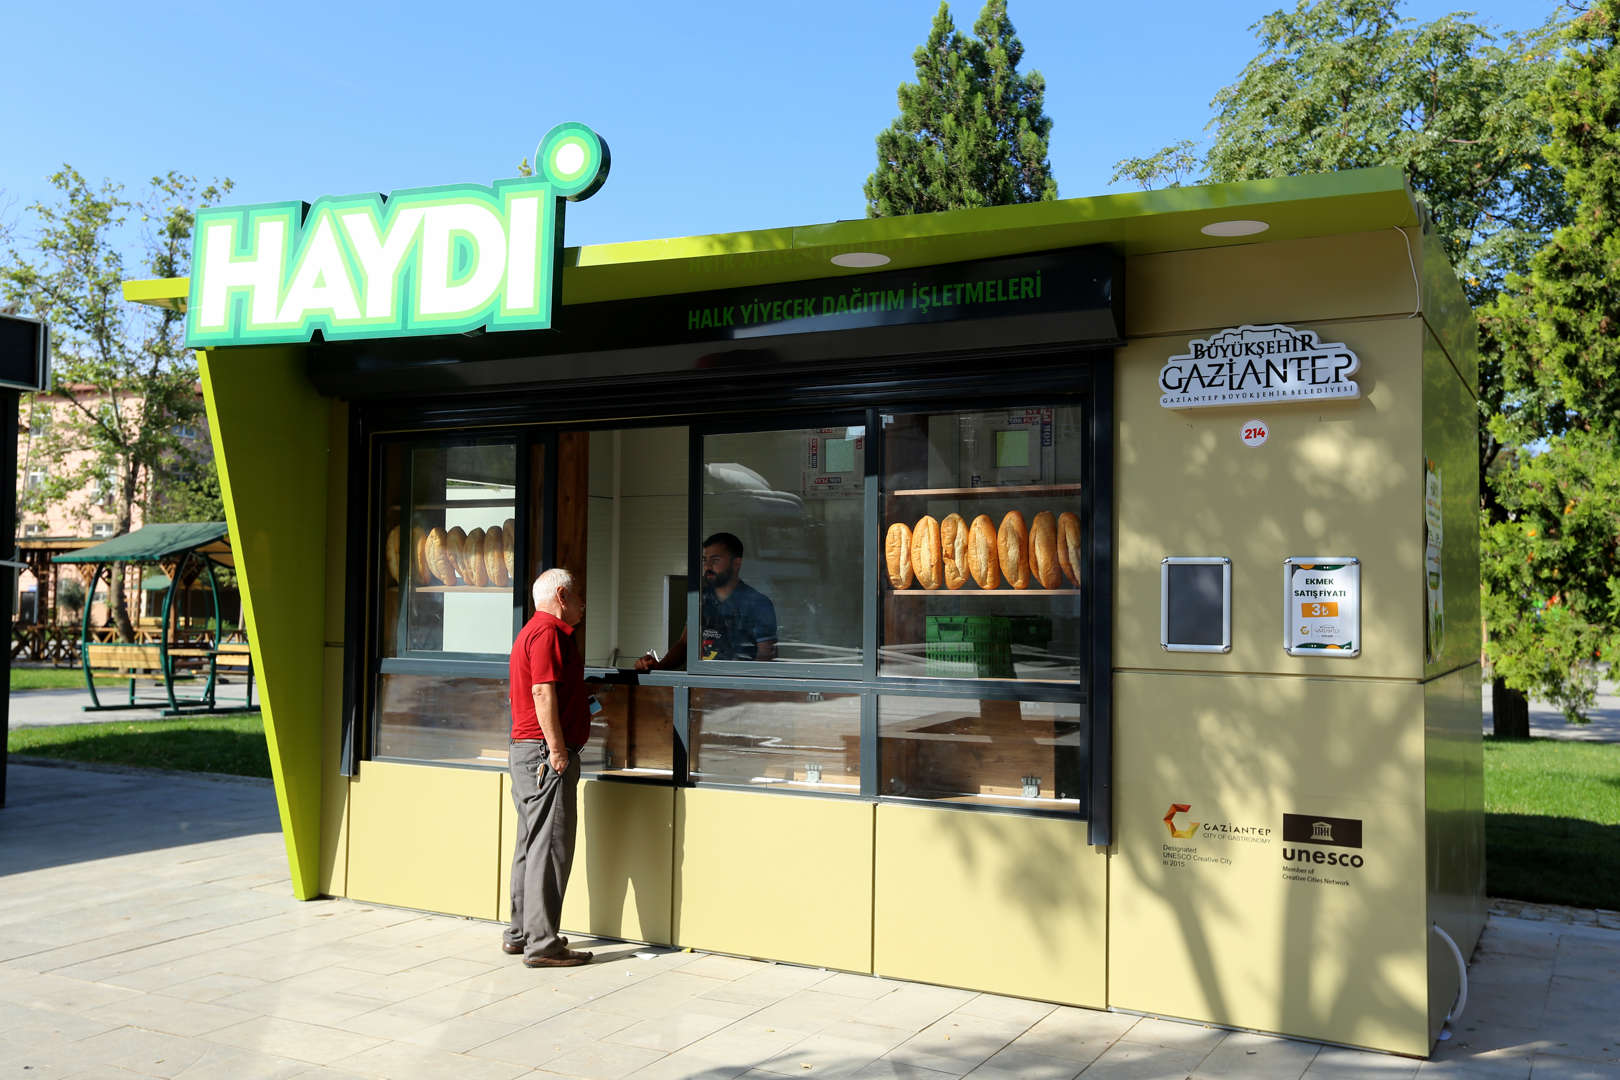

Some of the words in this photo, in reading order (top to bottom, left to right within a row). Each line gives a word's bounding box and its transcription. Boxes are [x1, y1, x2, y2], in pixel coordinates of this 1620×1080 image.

[194, 134, 590, 334] HAYDİ
[688, 306, 735, 330] HALK
[741, 298, 817, 324] YİYECEK
[822, 287, 905, 317] DAĞITIM
[911, 269, 1042, 314] İŞLETMELERİ
[1161, 354, 1352, 394] GAZİANTEP
[1162, 394, 1219, 404] GAZİANTEP
[1222, 389, 1287, 400] BÜYÜKŞEHİR
[1291, 385, 1354, 396] BELEDİYESİ
[1244, 427, 1266, 440] 214
[1294, 590, 1317, 598] SATIŞ
[1319, 589, 1346, 597] FİYATI
[1203, 822, 1271, 836] GAZİANTEP
[1162, 844, 1197, 853] Designated
[1162, 852, 1192, 861] UNESCO
[1193, 855, 1219, 863] Creative
[1220, 857, 1232, 866] City
[1282, 848, 1364, 868] unesco
[1282, 866, 1307, 874] Member
[1282, 874, 1306, 882] Creative
[1324, 878, 1350, 886] Network
